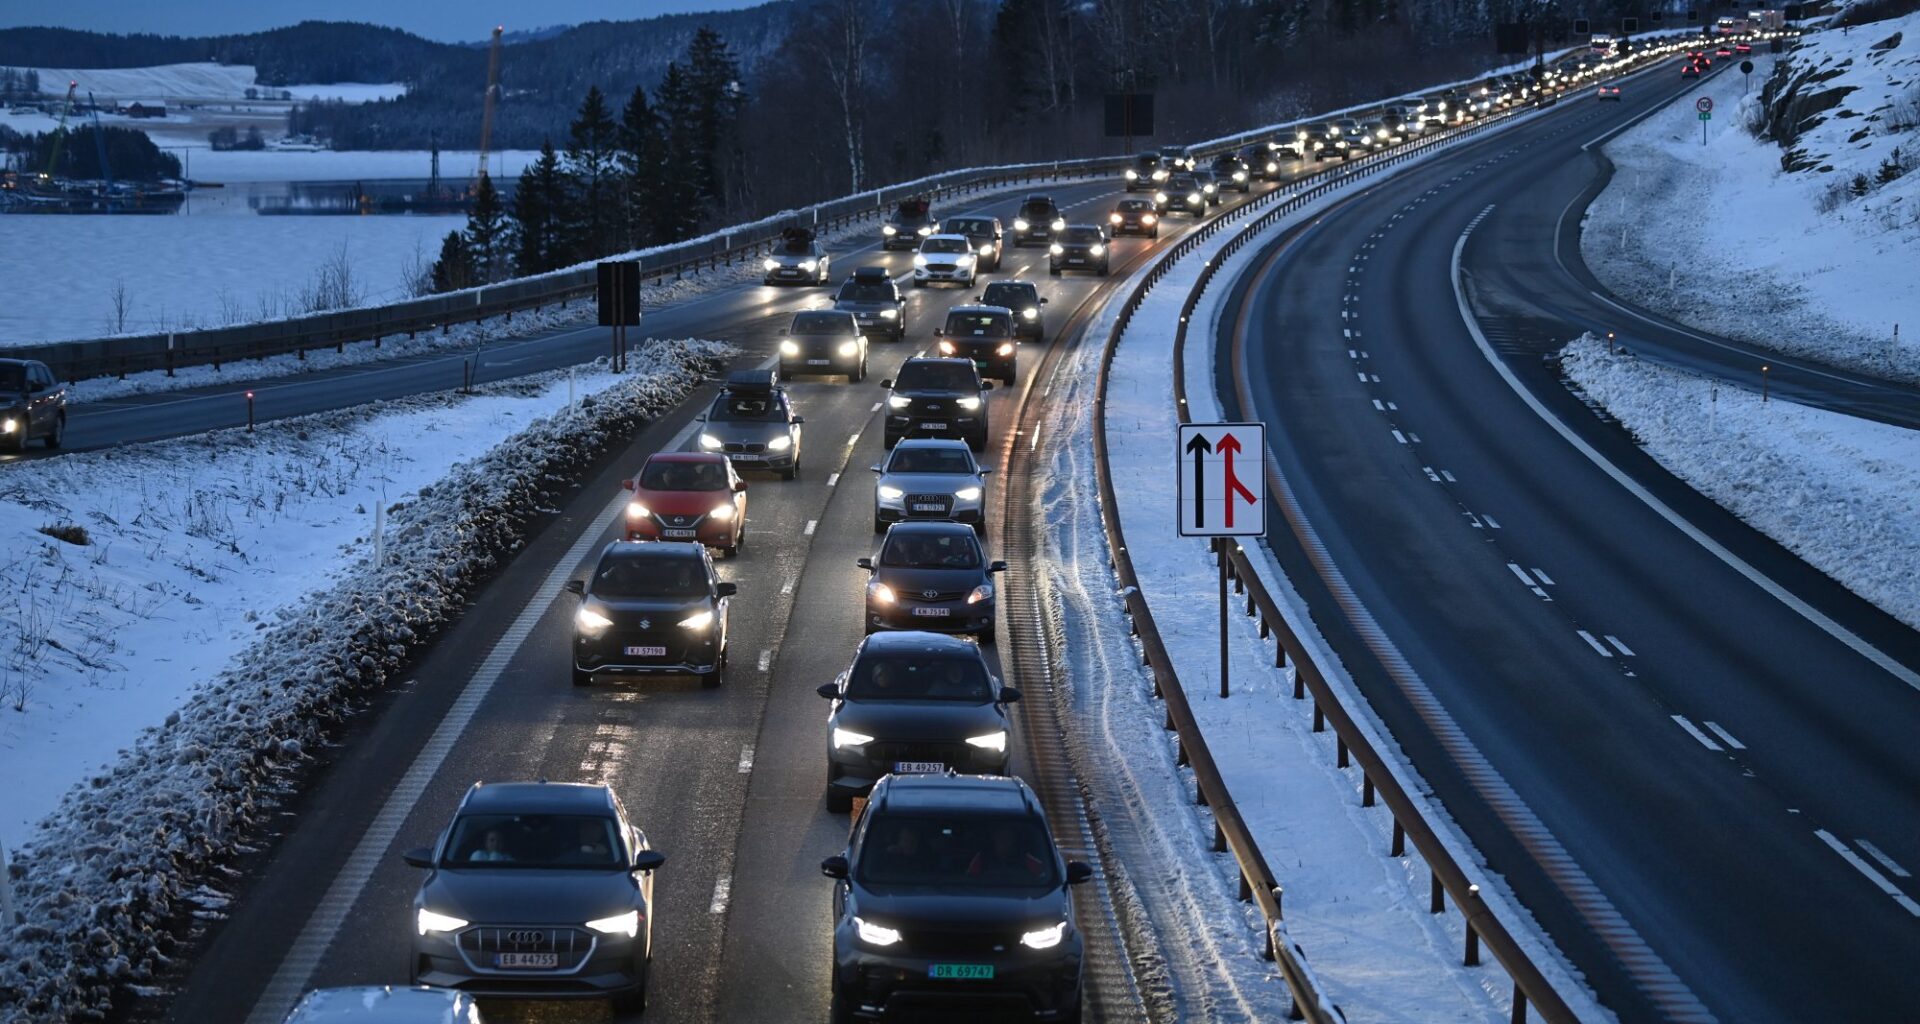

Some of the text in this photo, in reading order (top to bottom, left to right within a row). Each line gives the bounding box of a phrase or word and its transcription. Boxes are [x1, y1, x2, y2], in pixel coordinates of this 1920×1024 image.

[1700, 101, 1710, 109] 110
[901, 763, 942, 772] EB 49257
[503, 954, 554, 965] EB 44755
[937, 966, 991, 977] DR 69747
